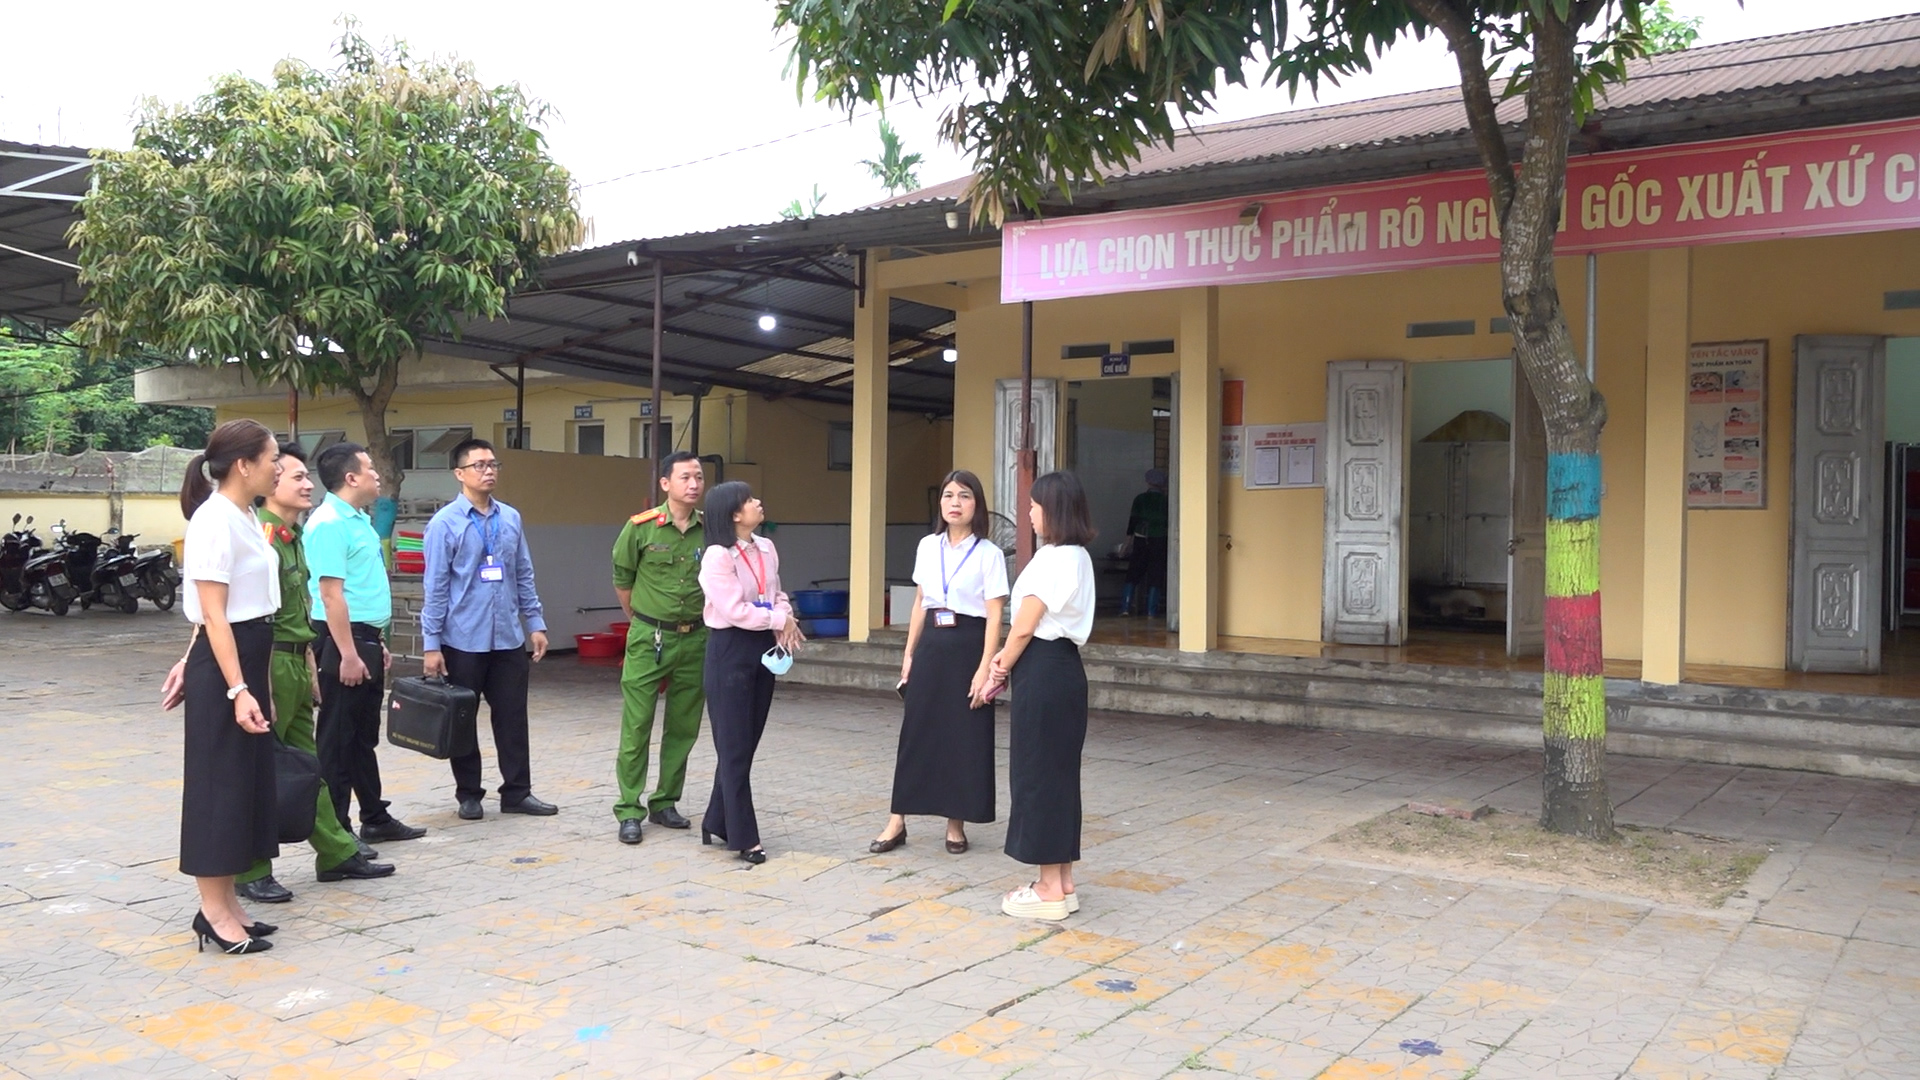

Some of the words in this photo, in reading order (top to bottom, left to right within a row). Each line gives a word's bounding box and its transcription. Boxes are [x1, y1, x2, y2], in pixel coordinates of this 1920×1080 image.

[1040, 238, 1090, 286] LỰA
[1097, 232, 1175, 280] CHỌN
[1184, 223, 1261, 272] THỰC
[1271, 197, 1368, 259] PHẨM
[1379, 196, 1425, 250] RÕ
[1580, 165, 1662, 231] GỐC
[1675, 150, 1791, 222] XUẤT
[1803, 144, 1875, 211] XỨ
[1884, 152, 1920, 204] C
